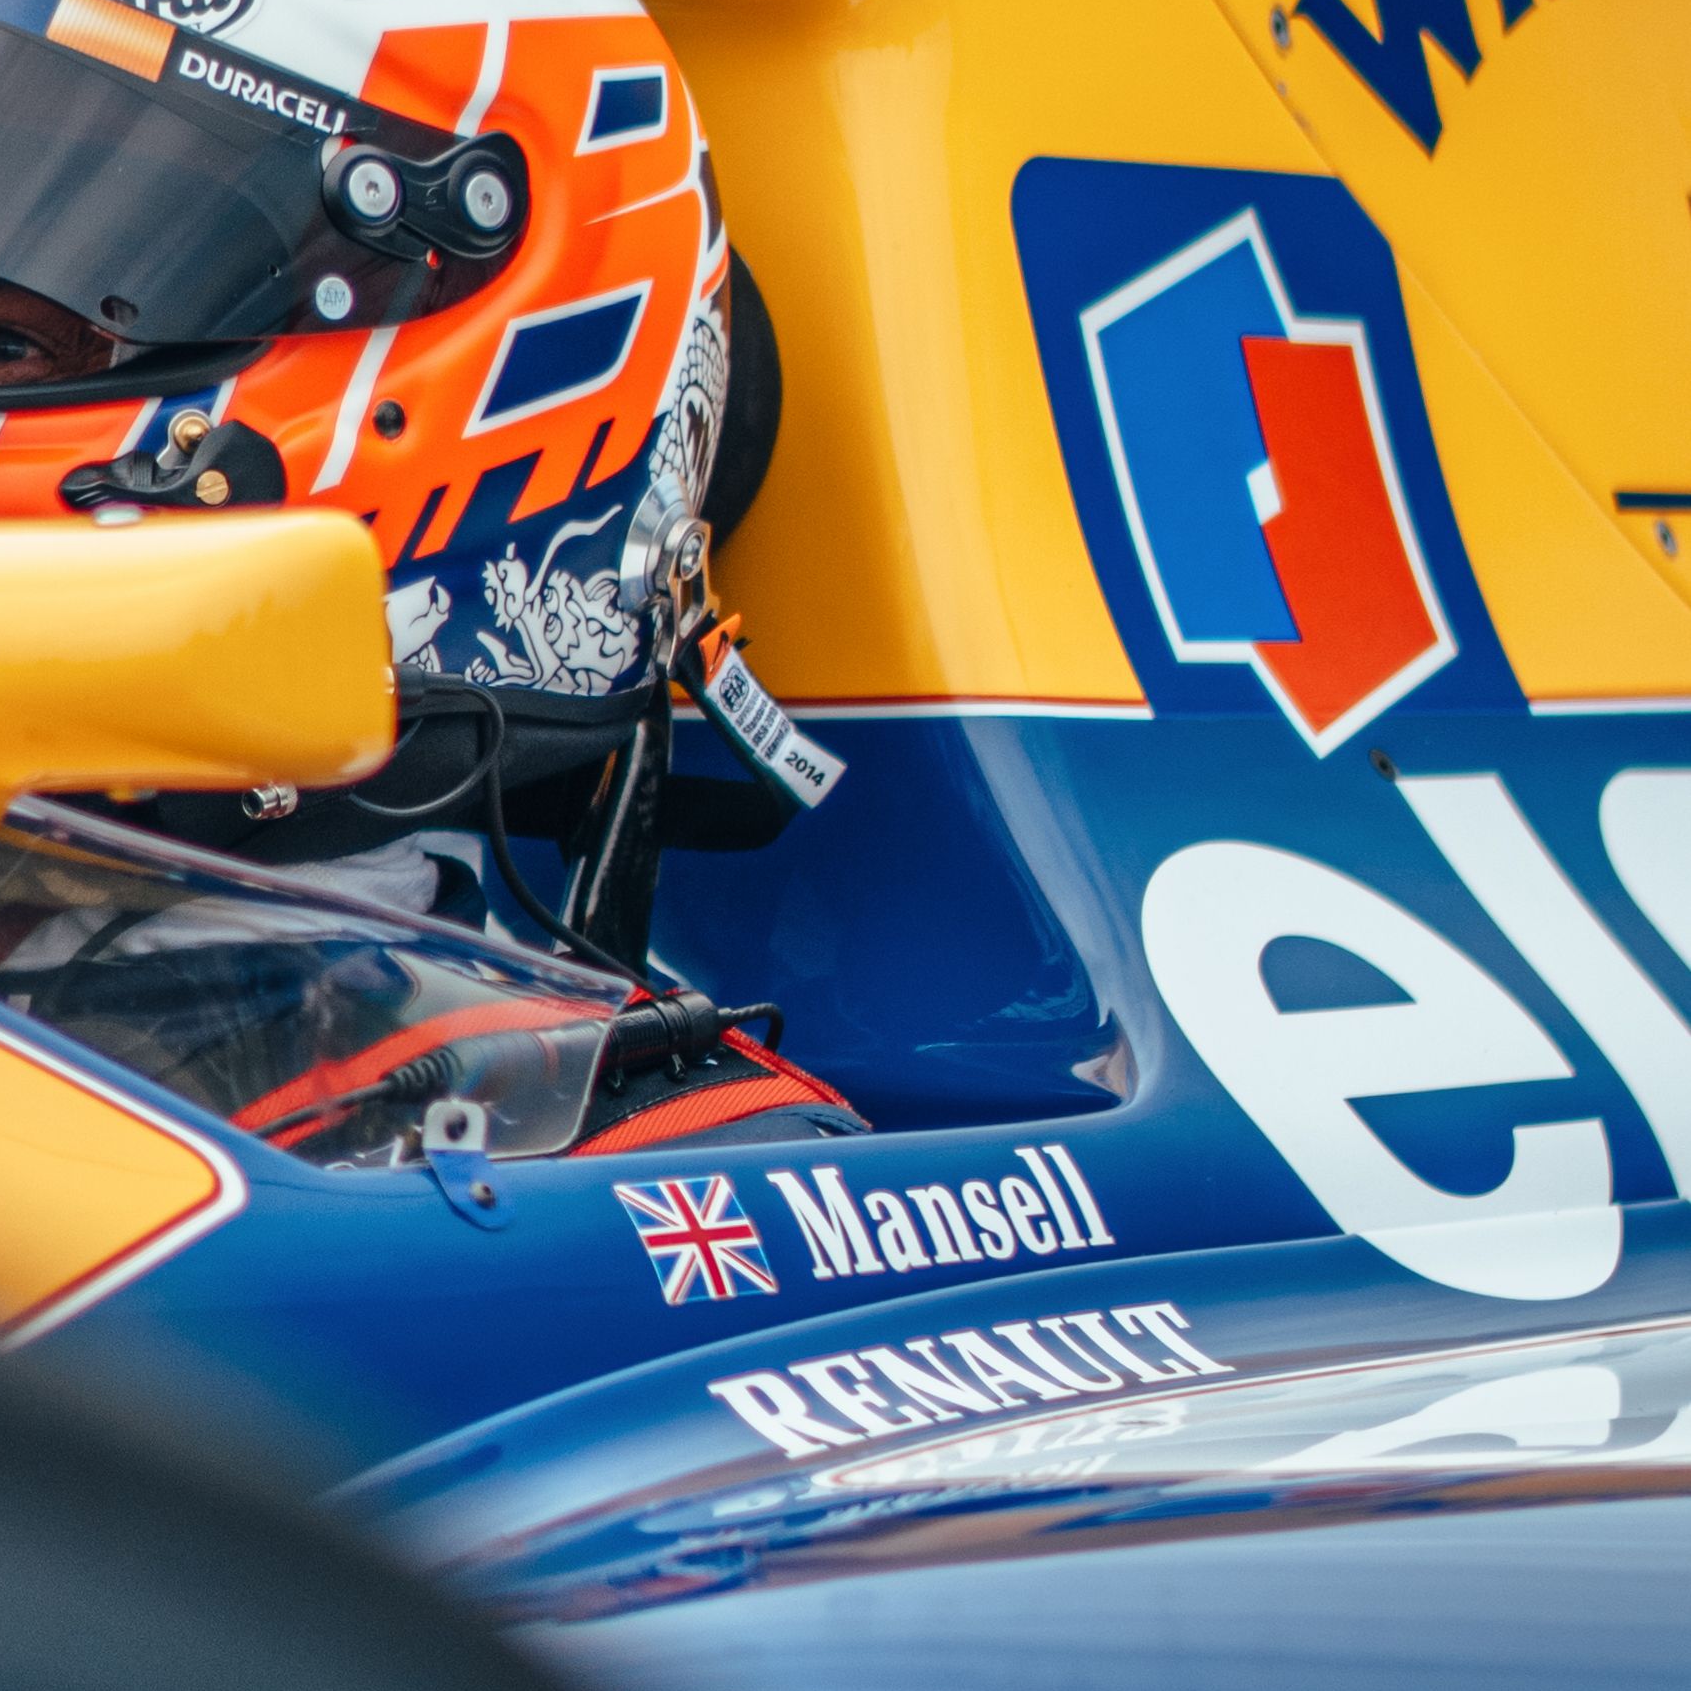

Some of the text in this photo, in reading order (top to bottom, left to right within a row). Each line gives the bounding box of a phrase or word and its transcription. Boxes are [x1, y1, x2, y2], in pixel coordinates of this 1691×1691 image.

[784, 751, 826, 787] 2014
[767, 1143, 1115, 1281] Mansell
[708, 1302, 1235, 1460] RENAULT
